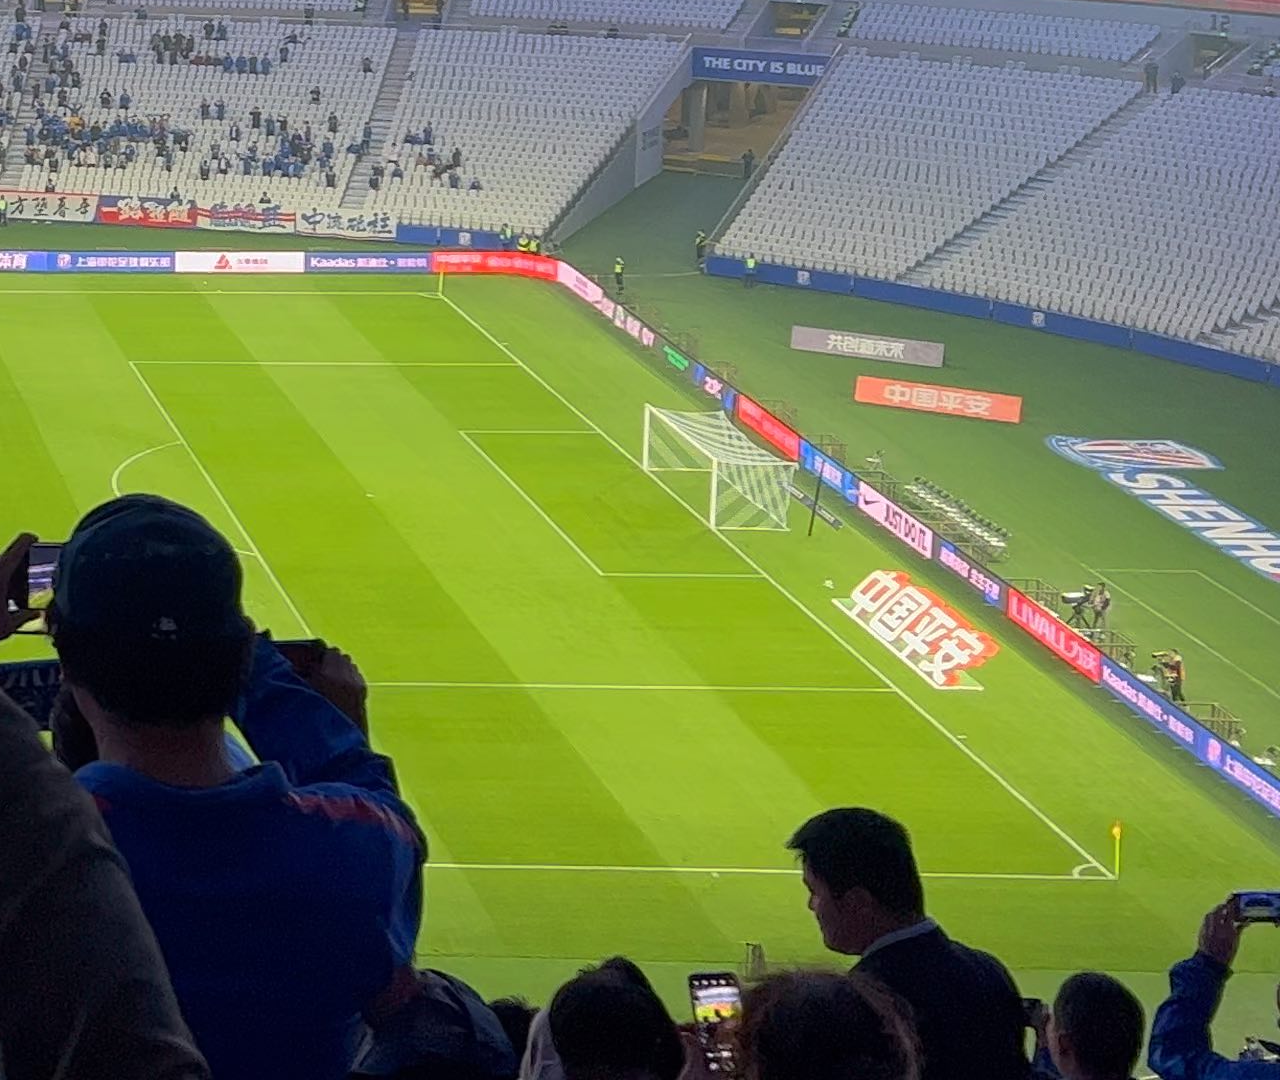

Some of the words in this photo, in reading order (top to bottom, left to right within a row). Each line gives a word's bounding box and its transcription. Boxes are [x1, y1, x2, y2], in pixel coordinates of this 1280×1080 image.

[702, 56, 732, 71] THE
[732, 58, 767, 74] CITY
[769, 61, 783, 75] IS
[783, 62, 825, 78] BLUE
[310, 257, 357, 268] Kaadas
[883, 384, 993, 417] 中国平安
[884, 503, 904, 533] JUST
[1107, 472, 1280, 583] SHENH
[850, 569, 986, 686] 中国平安
